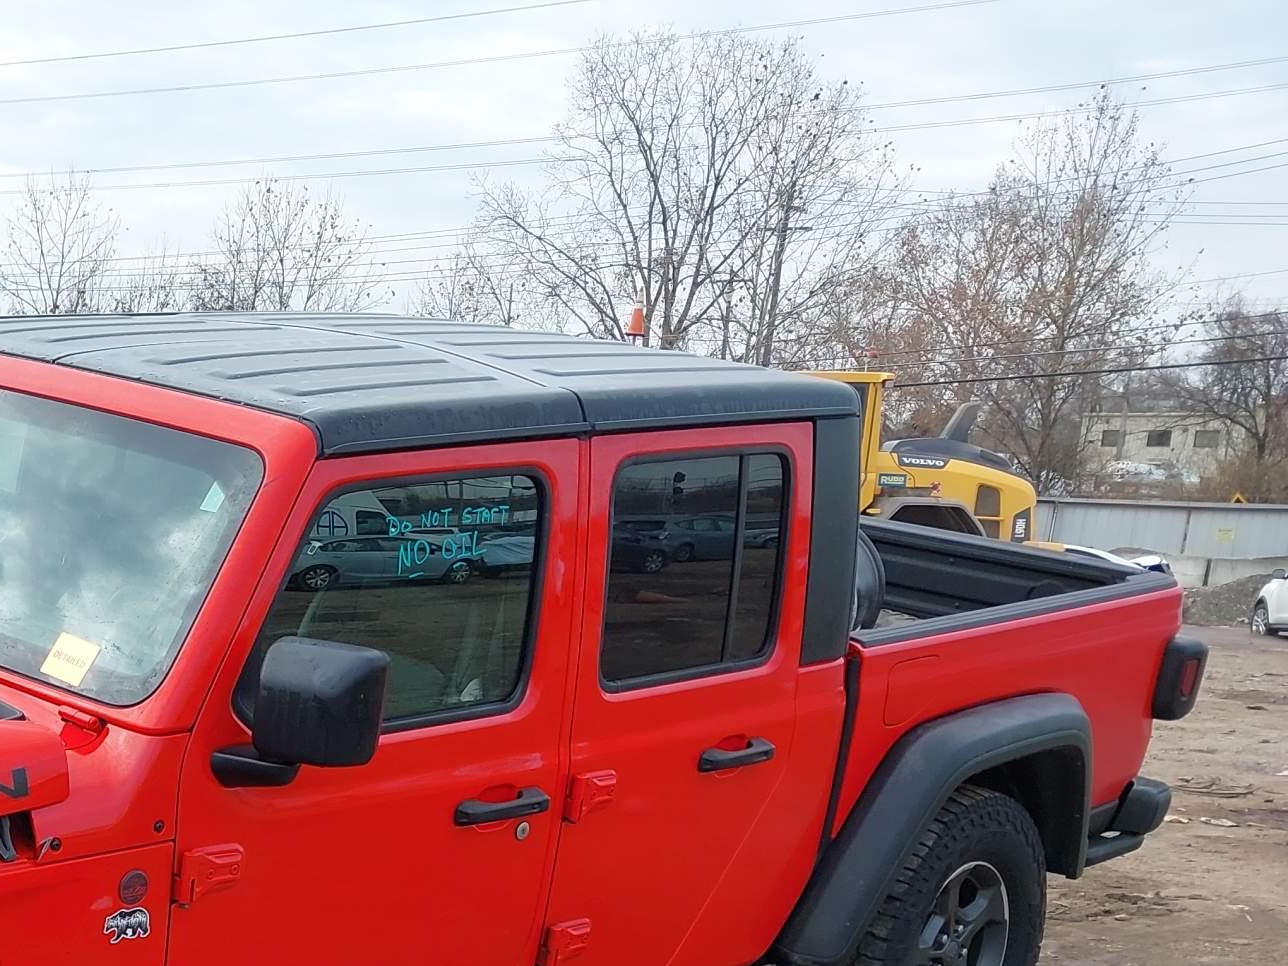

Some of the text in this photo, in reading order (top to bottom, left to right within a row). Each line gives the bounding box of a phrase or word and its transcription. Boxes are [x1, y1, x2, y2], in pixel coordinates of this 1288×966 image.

[902, 457, 945, 467] VOLVO
[421, 508, 452, 529] NOT
[462, 505, 510, 528] START
[398, 530, 487, 576] NO OIL
